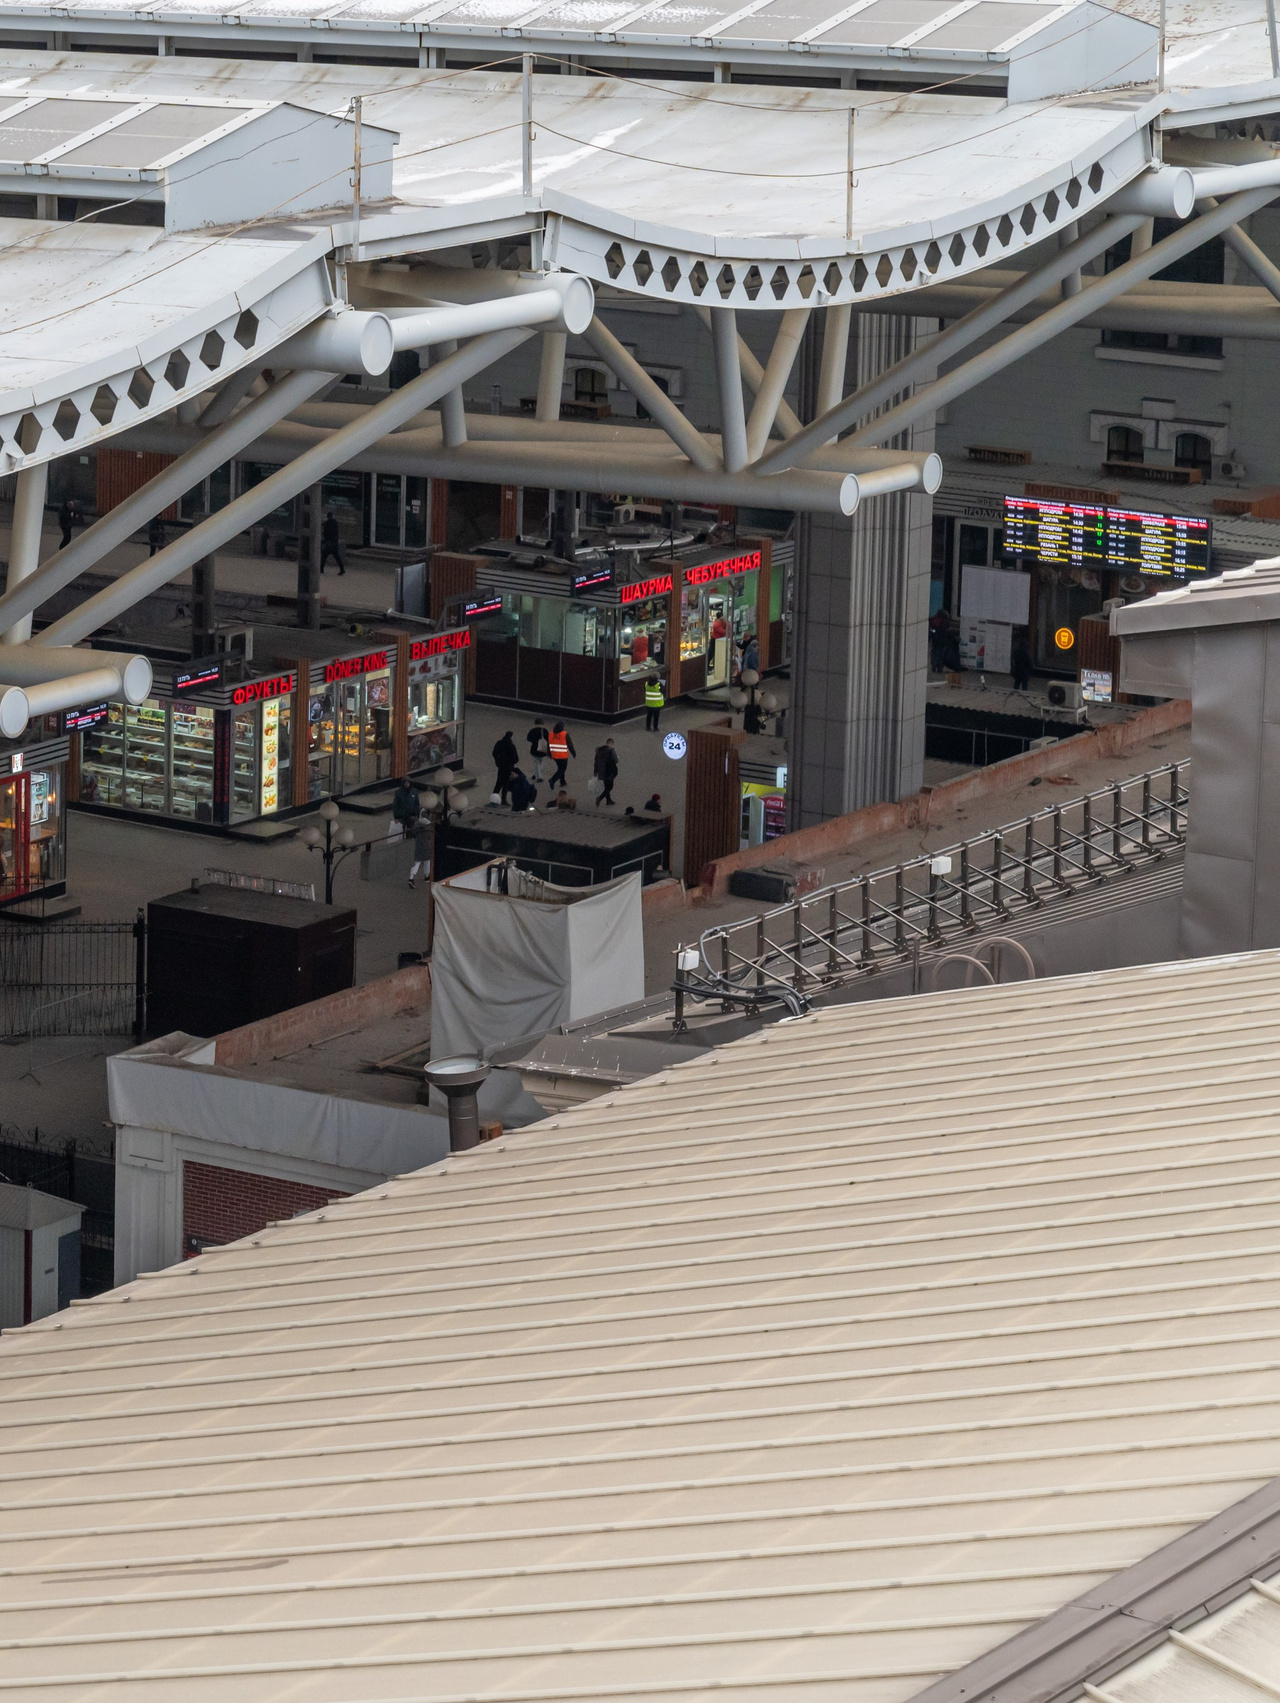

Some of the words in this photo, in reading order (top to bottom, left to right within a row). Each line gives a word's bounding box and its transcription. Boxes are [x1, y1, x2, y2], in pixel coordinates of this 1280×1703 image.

[963, 508, 1003, 519] ПРОДУКТ
[686, 551, 761, 585] ЧЕБУРЕЧНАЯ
[622, 575, 673, 603] ШАУРМА
[412, 630, 470, 660] ВЫПЕЧКА
[325, 658, 361, 683] DÖNER
[363, 651, 388, 672] KING
[234, 674, 293, 705] ФРУКТЫ
[669, 742, 681, 750] 24
